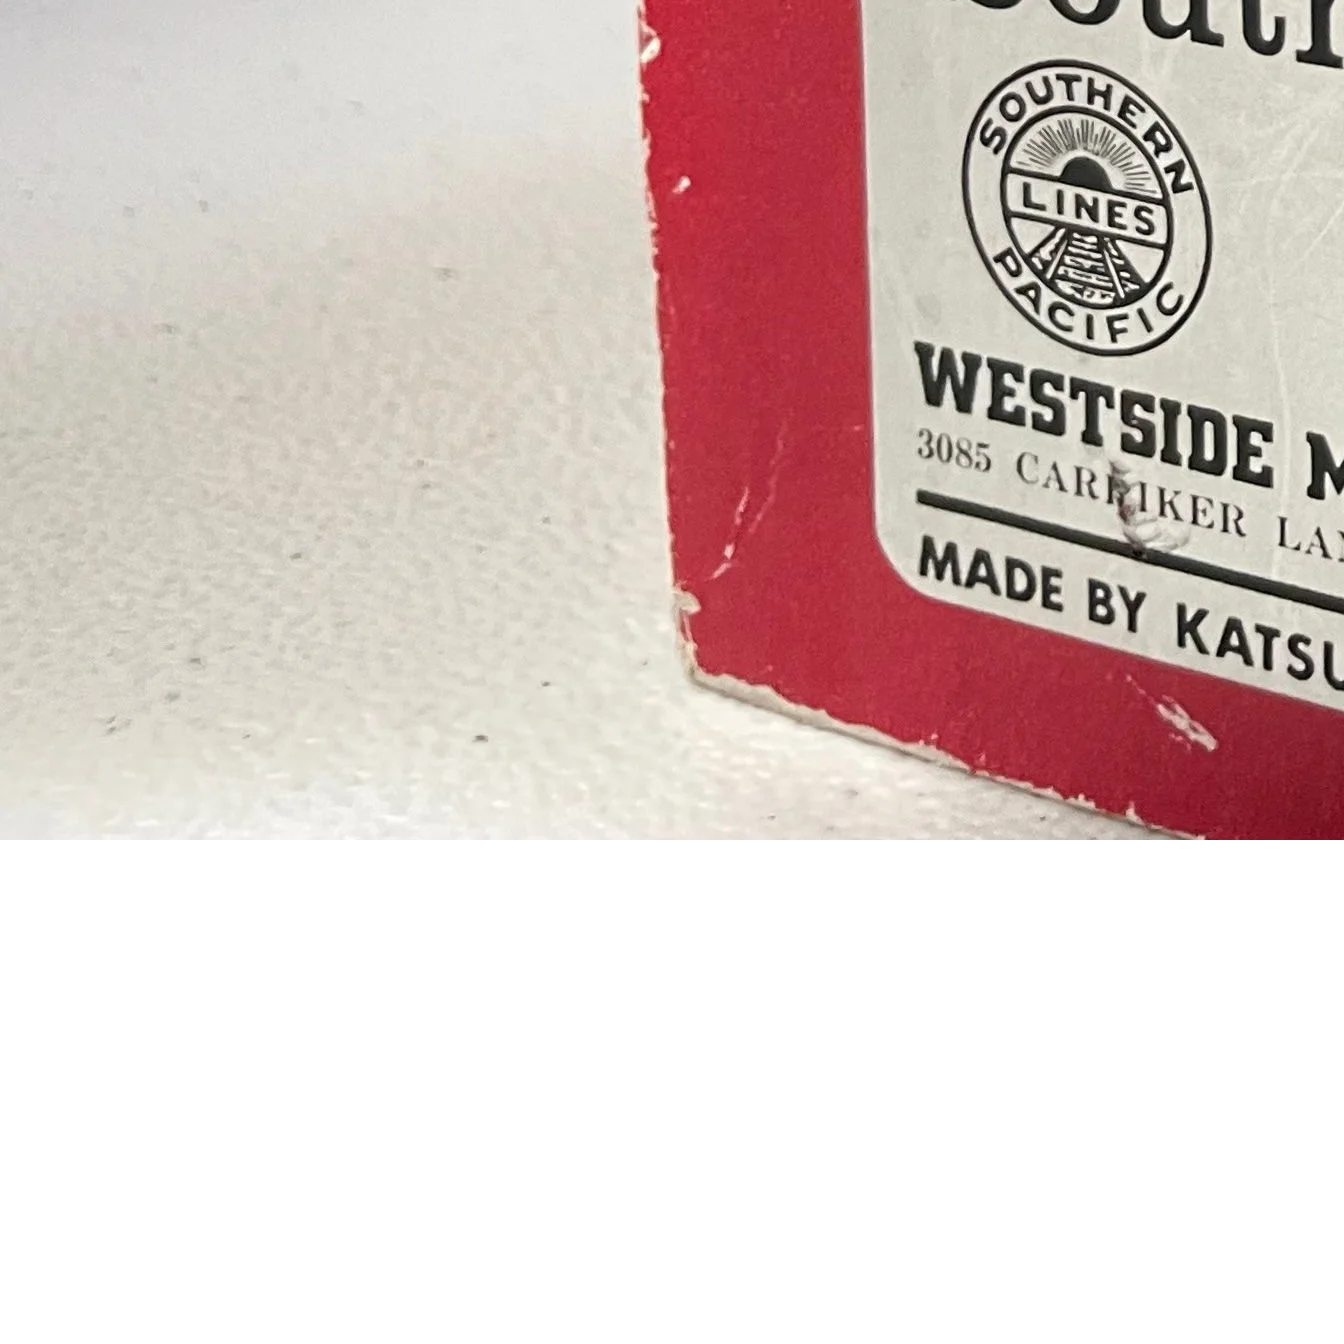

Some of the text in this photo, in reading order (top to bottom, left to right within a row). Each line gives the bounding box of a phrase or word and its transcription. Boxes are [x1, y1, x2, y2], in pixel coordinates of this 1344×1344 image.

[979, 73, 1194, 195] SOUTHERN
[1022, 181, 1156, 237] LINES
[992, 246, 1185, 344] PACIFIC
[914, 340, 1275, 488] WESTSIDE
[916, 428, 992, 474] 3085
[918, 535, 1063, 612] MADE
[1087, 577, 1147, 634] BY
